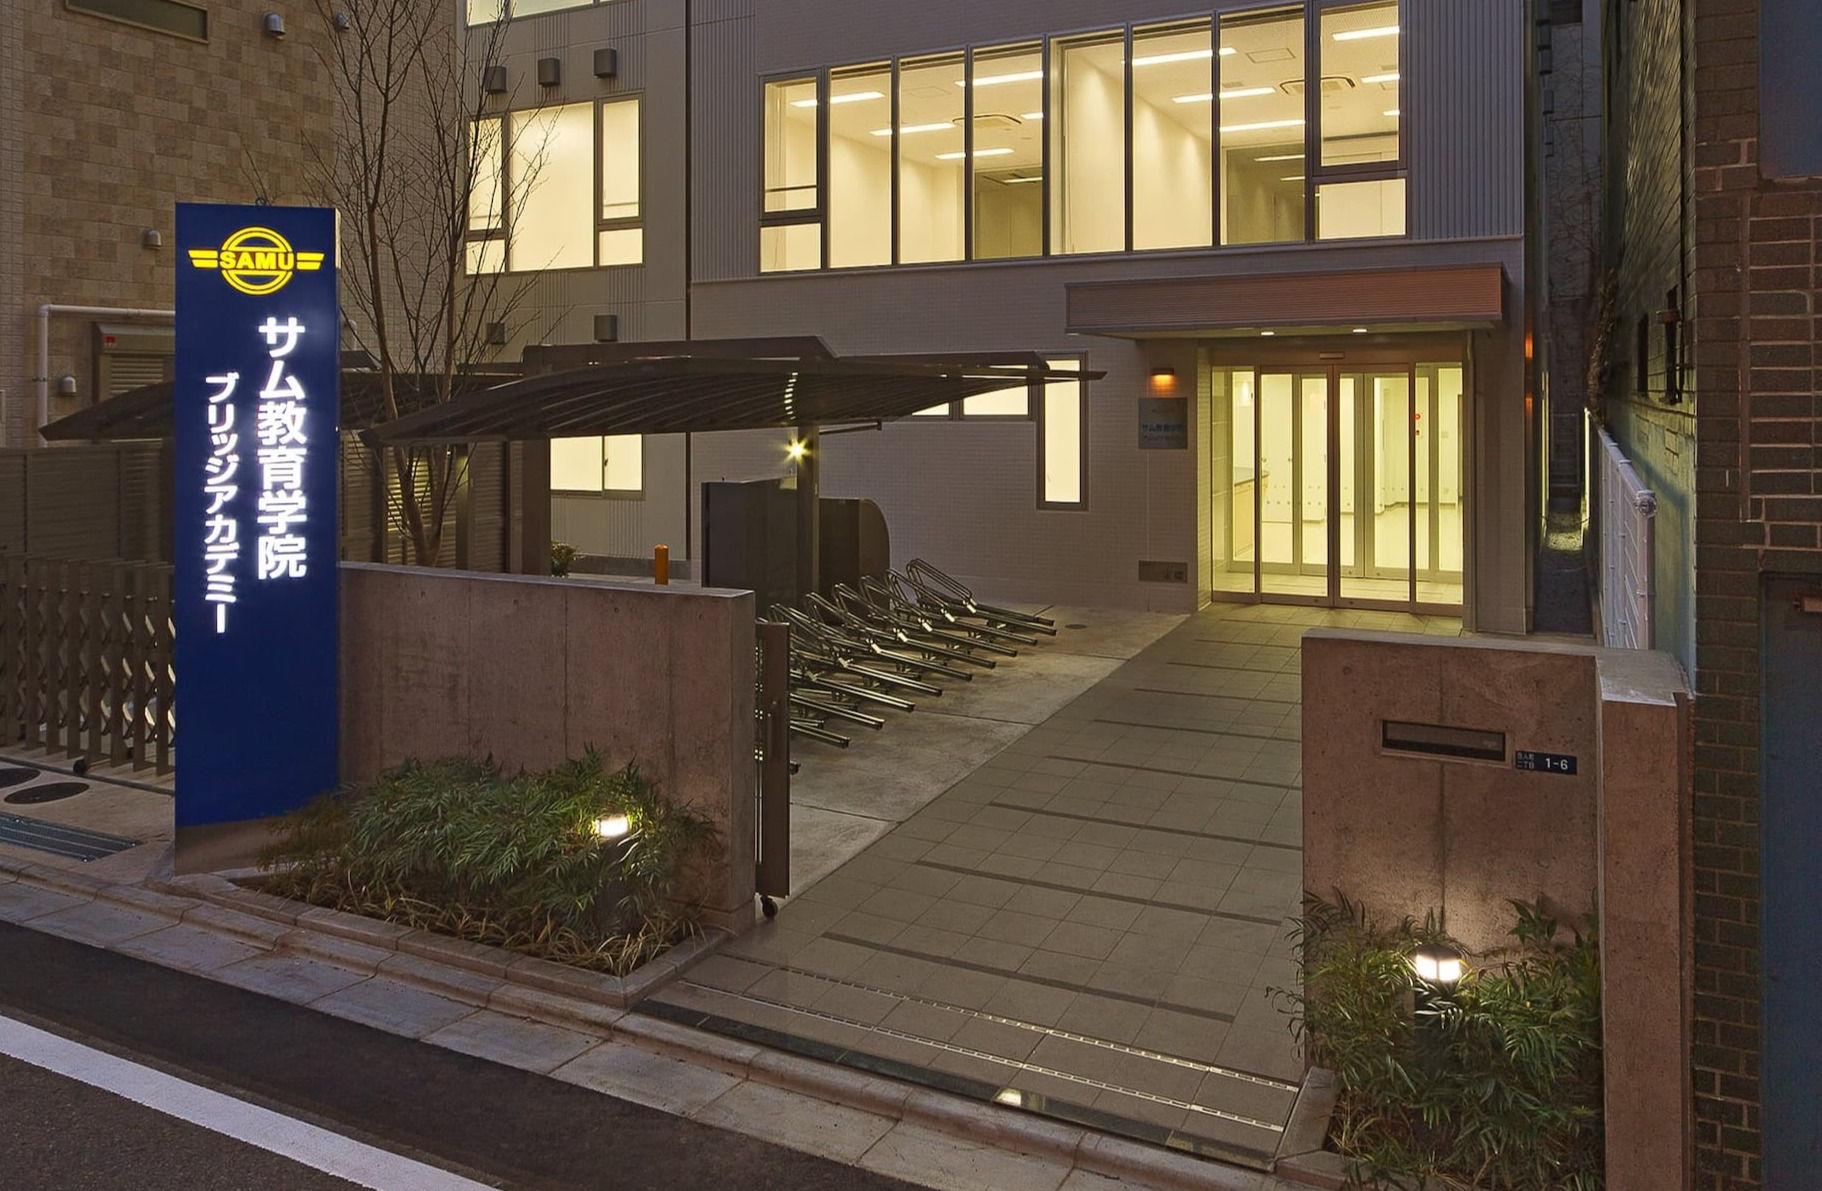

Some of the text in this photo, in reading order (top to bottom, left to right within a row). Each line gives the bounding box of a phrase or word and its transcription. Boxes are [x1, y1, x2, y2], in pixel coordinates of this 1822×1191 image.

[219, 251, 295, 270] SAMU
[204, 371, 240, 634] ブリッジアカデミー
[258, 316, 307, 580] サム教育学院
[1545, 758, 1569, 770] 1-6
